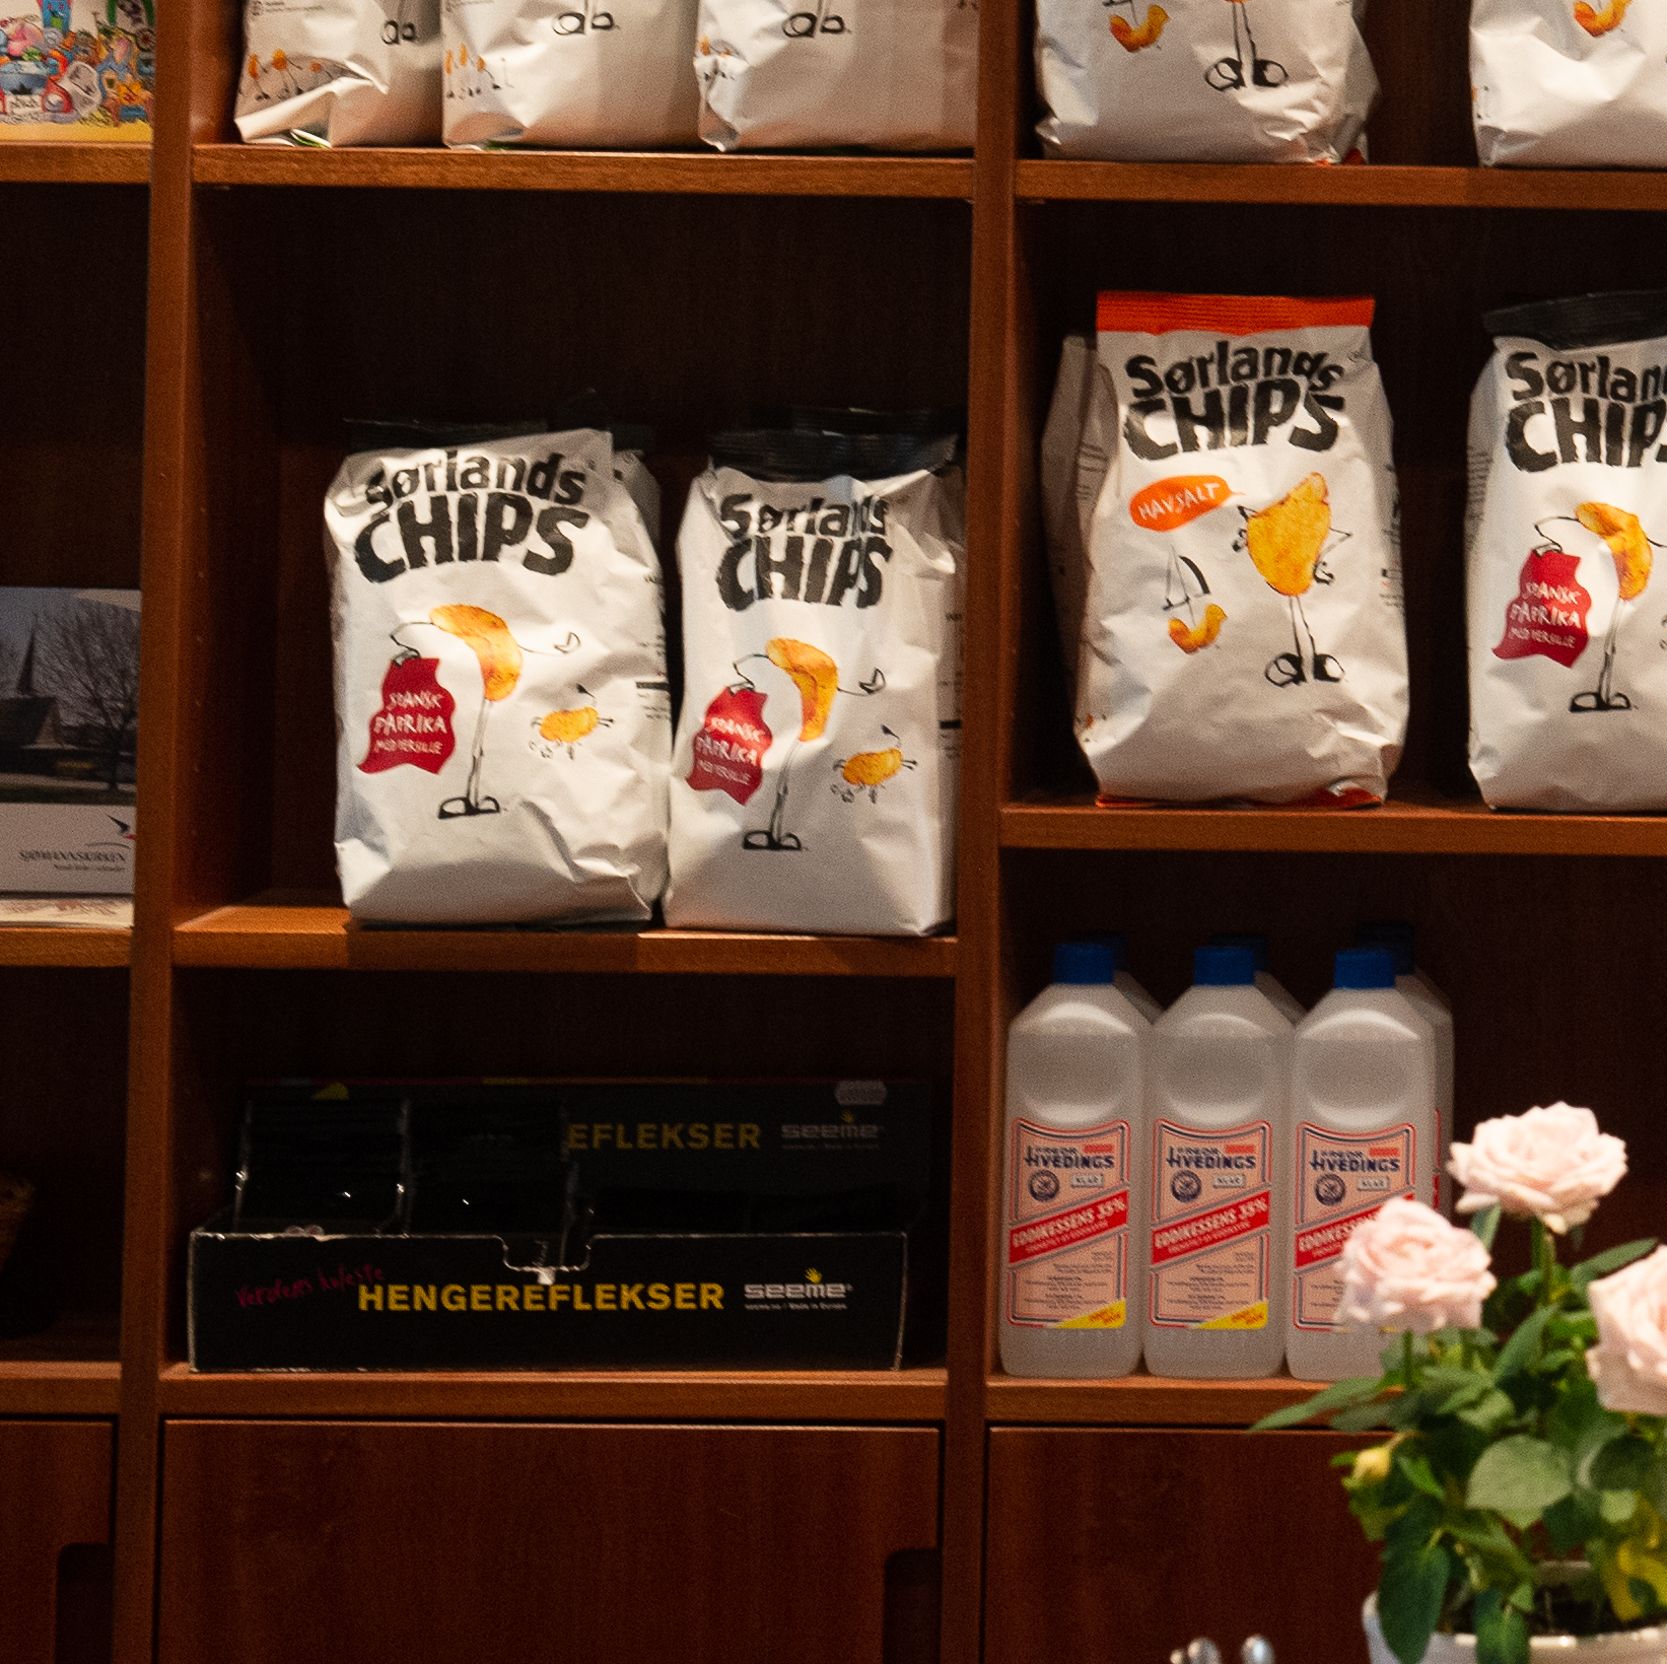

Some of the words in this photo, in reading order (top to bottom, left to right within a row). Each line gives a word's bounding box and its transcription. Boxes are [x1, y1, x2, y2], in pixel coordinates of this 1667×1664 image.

[1126, 340, 1344, 399] Sørlands
[1122, 378, 1344, 462] CHIPS
[366, 448, 587, 505] Sørlands
[1137, 481, 1219, 520] HAVSALT
[354, 490, 589, 583] CHIPS
[1509, 603, 1582, 629] PAPRIKA
[373, 713, 447, 734] PAPRIKA
[695, 735, 757, 766] PAPRIKA
[1024, 1149, 1114, 1169] HVEDINGS
[1166, 1149, 1256, 1170] HVEDINGS
[1309, 1153, 1400, 1173] HVEDINGS
[359, 1282, 724, 1312] HENGEREFLEKSER
